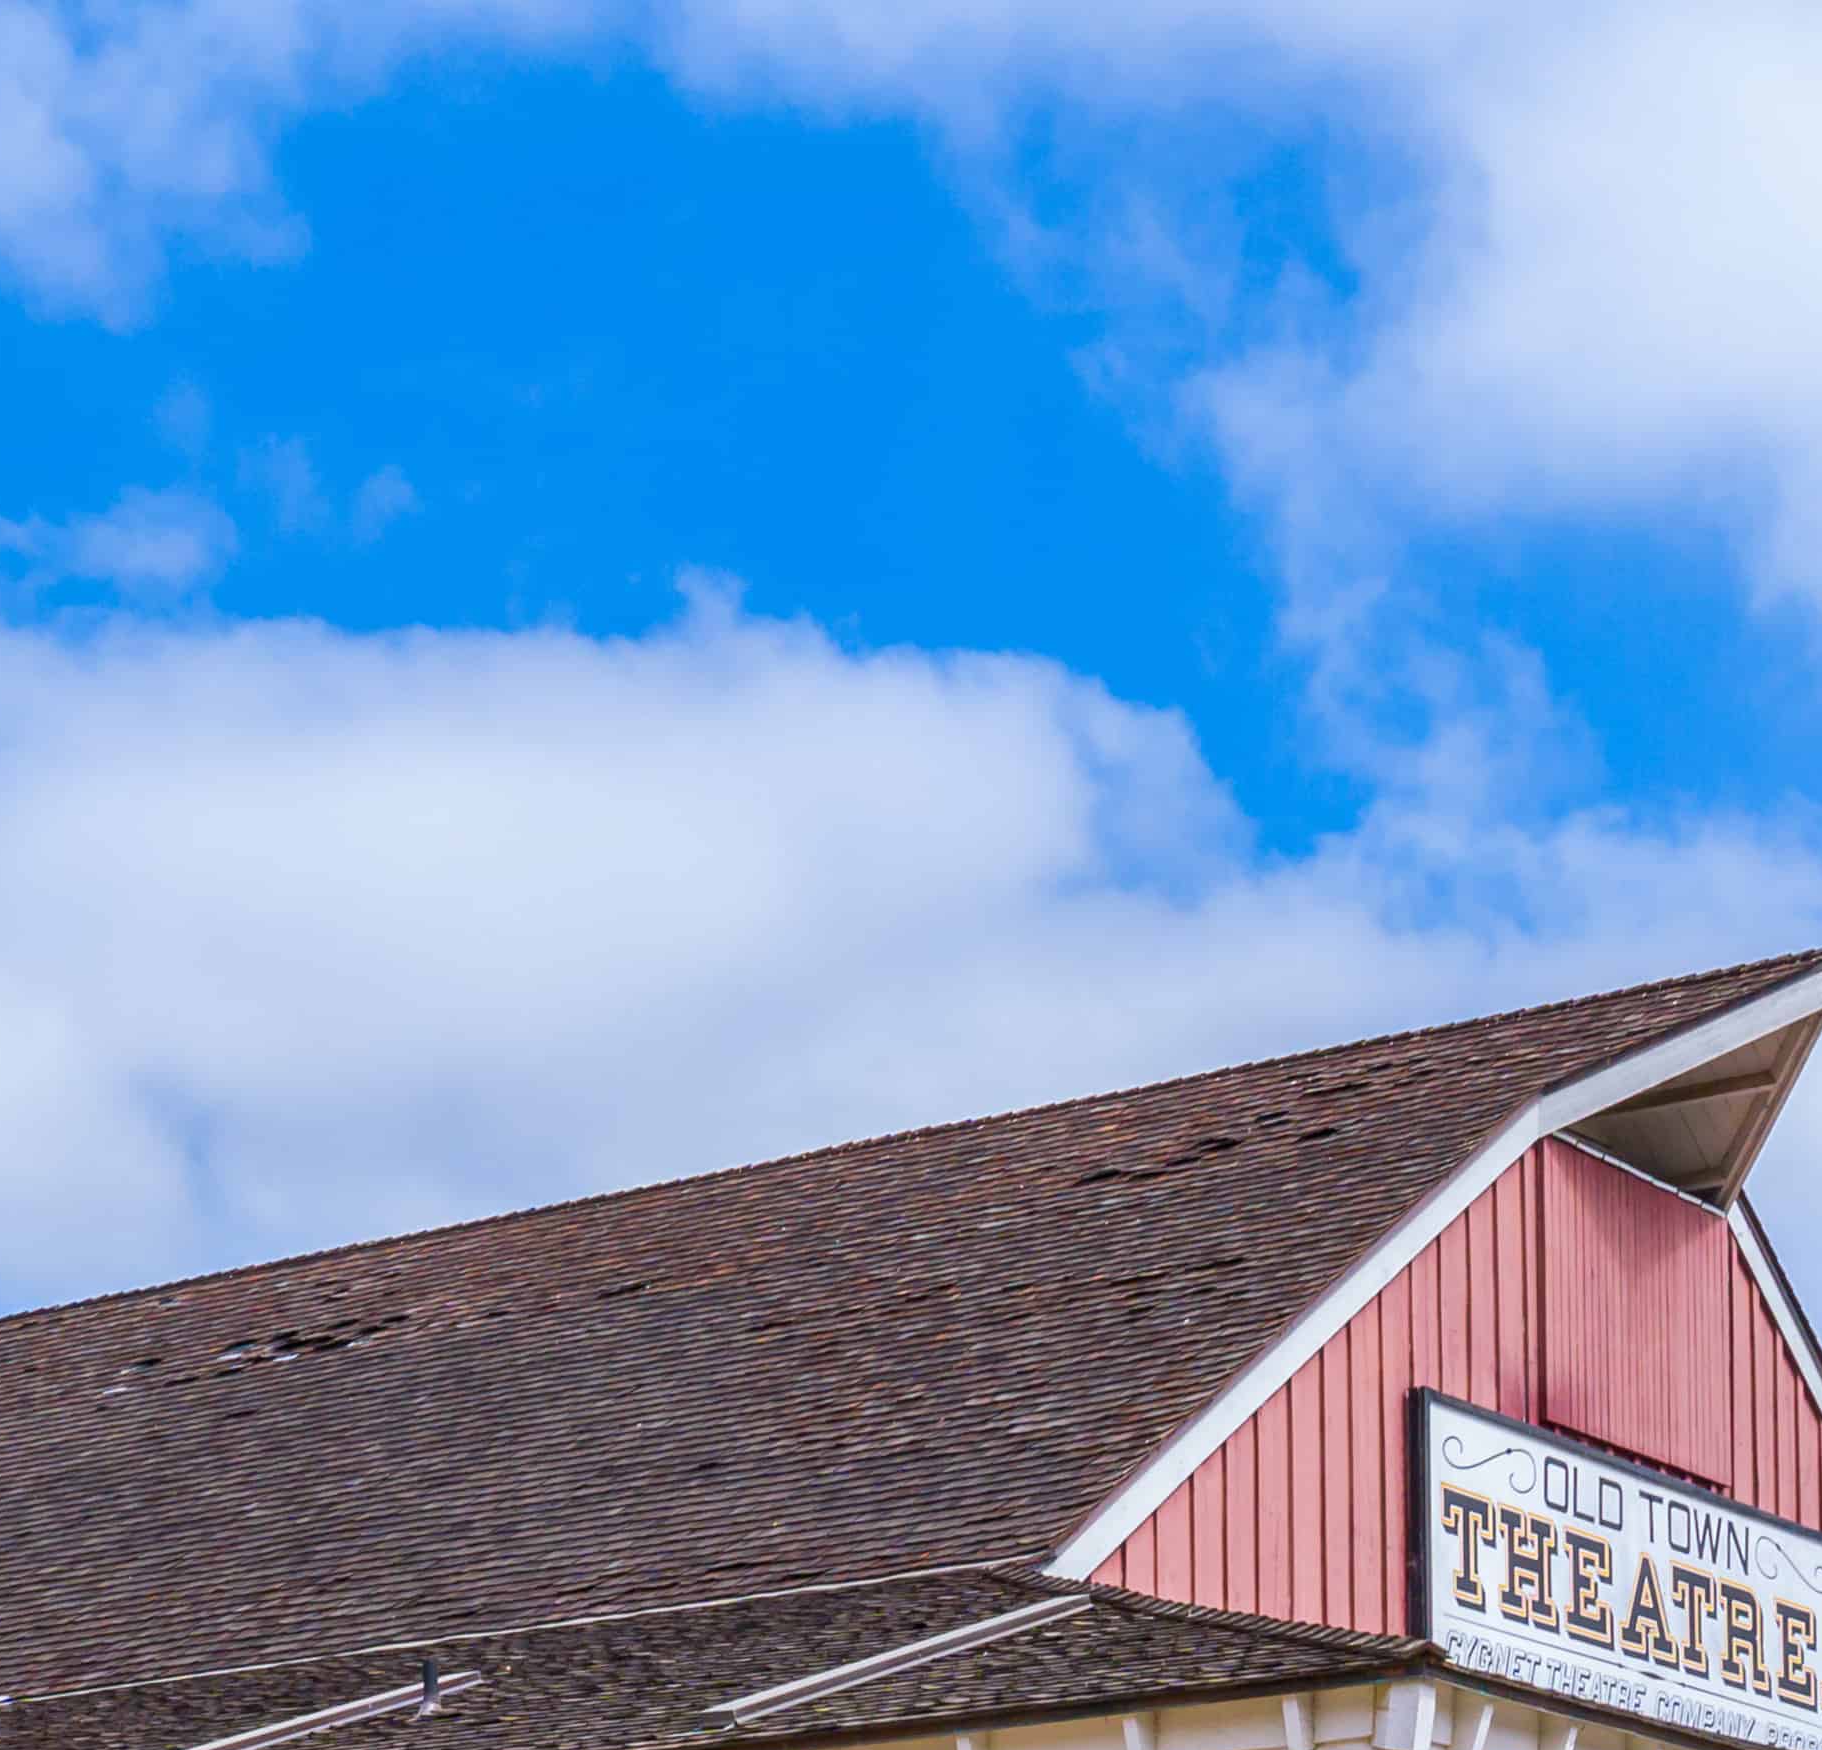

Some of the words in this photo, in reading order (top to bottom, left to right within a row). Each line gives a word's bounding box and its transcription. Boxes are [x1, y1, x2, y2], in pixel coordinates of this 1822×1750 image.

[1544, 1456, 1623, 1532] OLD
[1638, 1490, 1750, 1577] TOWN
[1446, 1628, 1542, 1686] CYGNET
[1546, 1657, 1647, 1711] THEATRE
